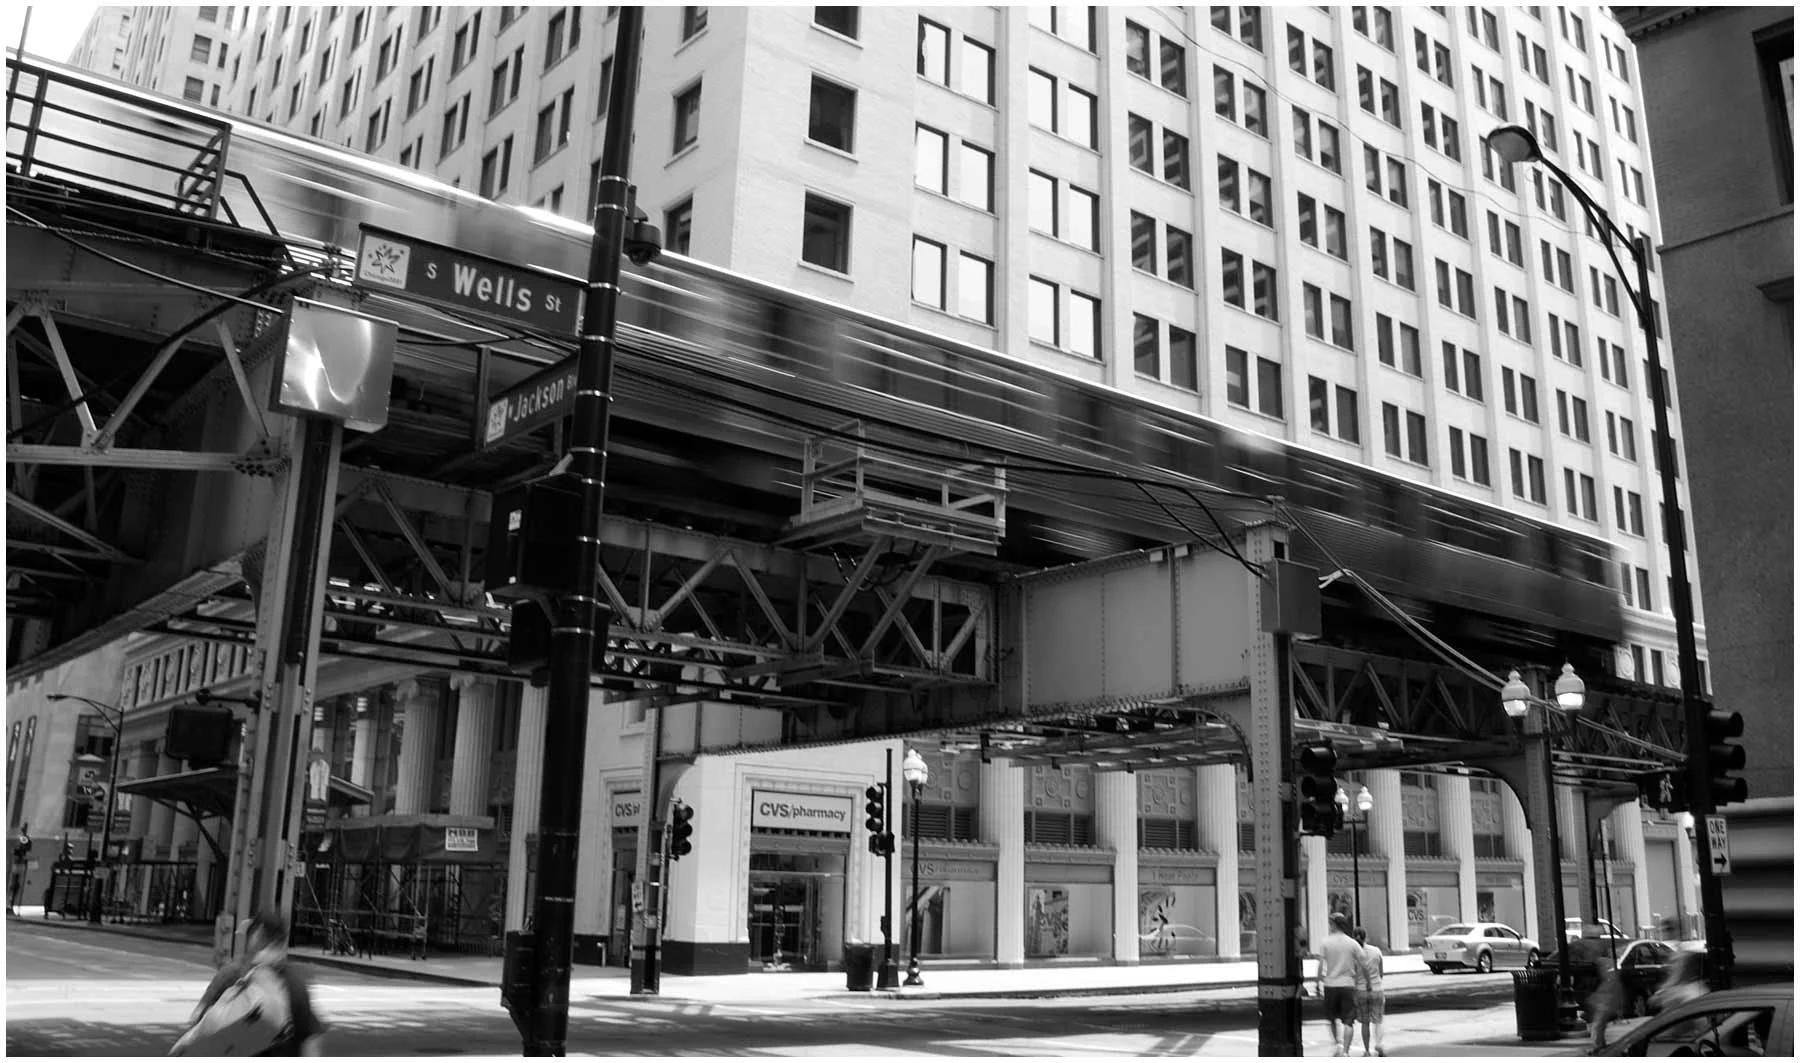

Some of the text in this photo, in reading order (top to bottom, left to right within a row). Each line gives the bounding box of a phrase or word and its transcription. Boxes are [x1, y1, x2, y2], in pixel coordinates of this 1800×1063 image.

[426, 262, 438, 280] S
[453, 262, 533, 312] Wells
[544, 294, 562, 313] St
[513, 378, 564, 422] Jackson
[760, 802, 847, 822] CVS/pharmacy
[1709, 820, 1725, 834] ONE
[1711, 837, 1726, 849] WAY
[1407, 909, 1425, 921] CVS
